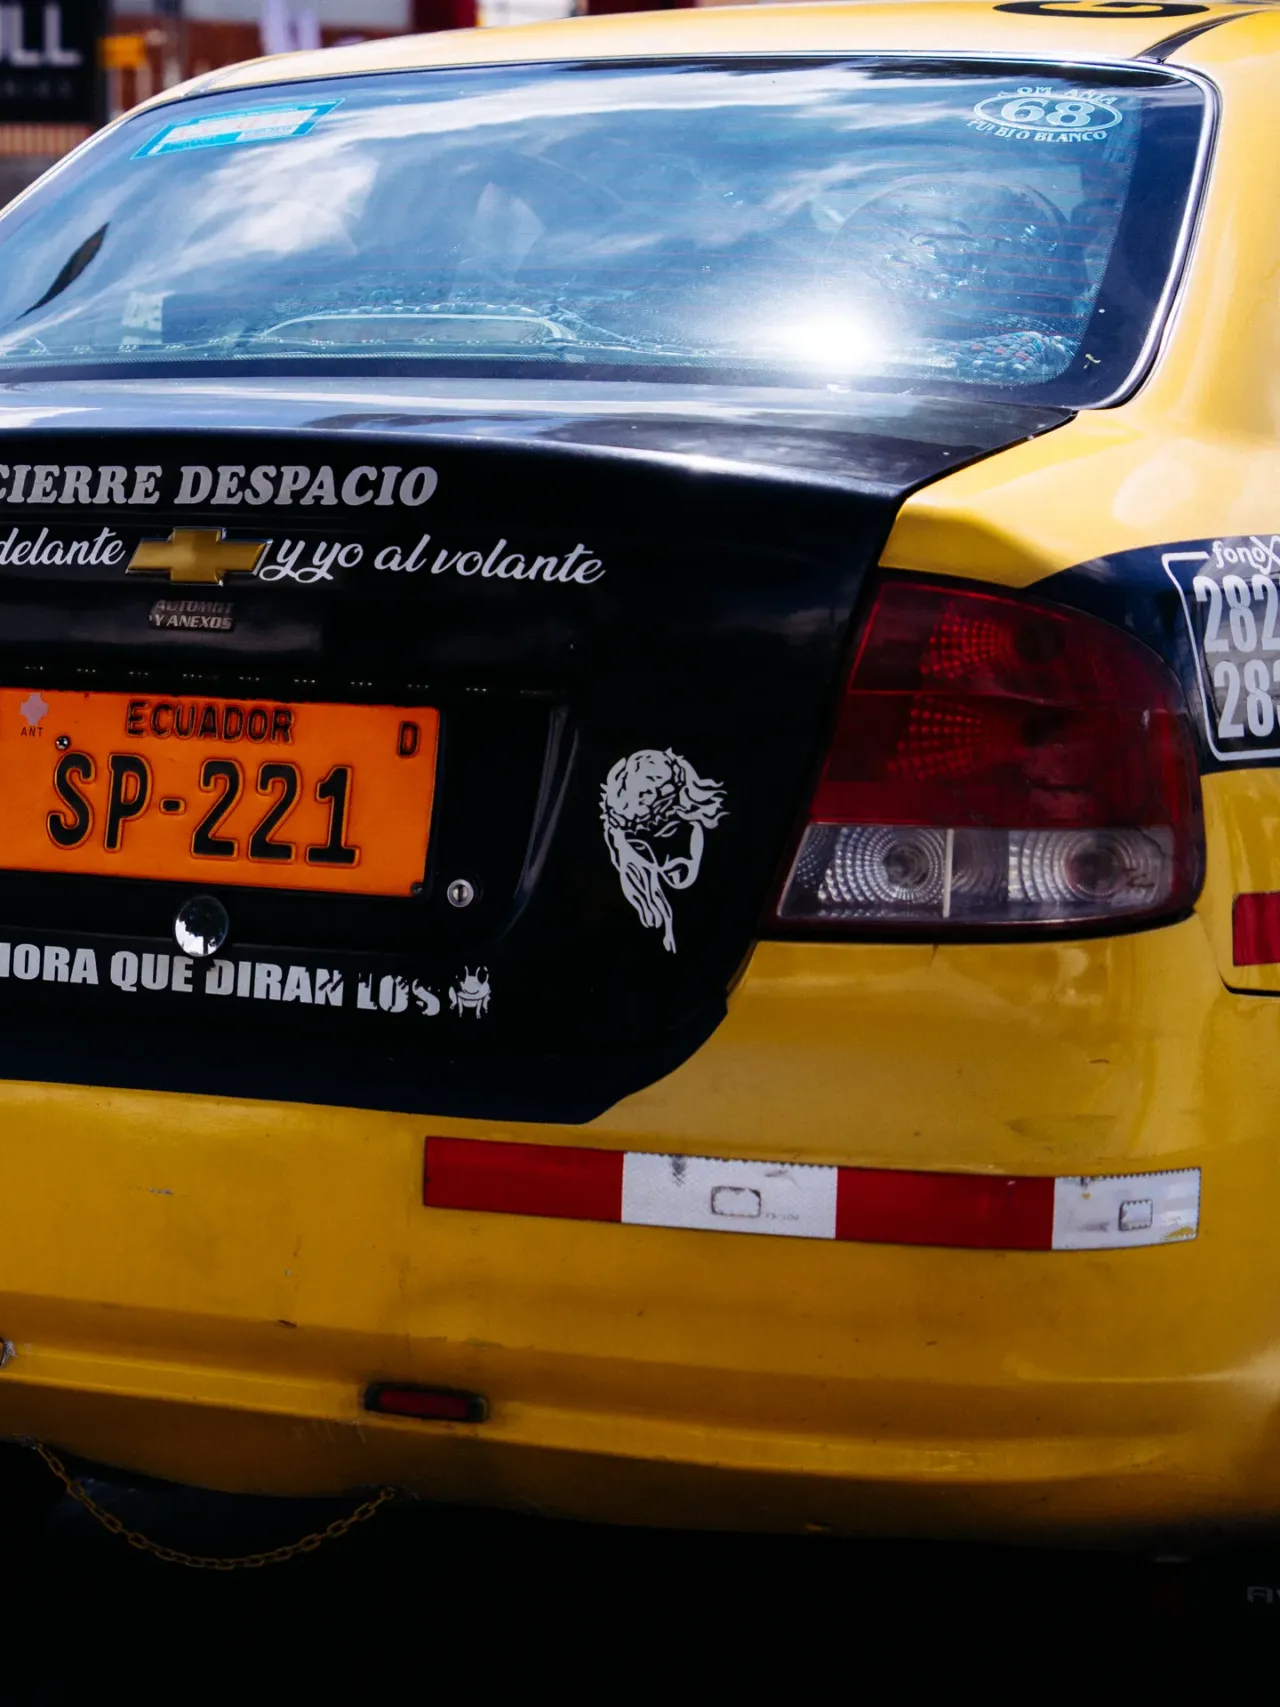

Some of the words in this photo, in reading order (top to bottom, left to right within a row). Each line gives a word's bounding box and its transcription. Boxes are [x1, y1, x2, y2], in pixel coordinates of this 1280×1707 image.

[997, 86, 1118, 105] OMAÑIA
[1001, 97, 1095, 127] 68
[1033, 130, 1108, 143] BLANCO
[174, 465, 439, 506] DESPACIO
[294, 541, 364, 583] yo
[374, 534, 432, 574] al
[431, 538, 607, 585] volante
[154, 614, 165, 627] Y
[166, 614, 234, 631] ANEXOS
[1213, 659, 1280, 739] 28
[20, 726, 44, 738] ANT
[126, 700, 295, 744] ECUADOR
[397, 721, 419, 759] D
[46, 751, 362, 867] SP-221
[110, 950, 194, 993] QUE
[204, 957, 345, 1007] DIRAN
